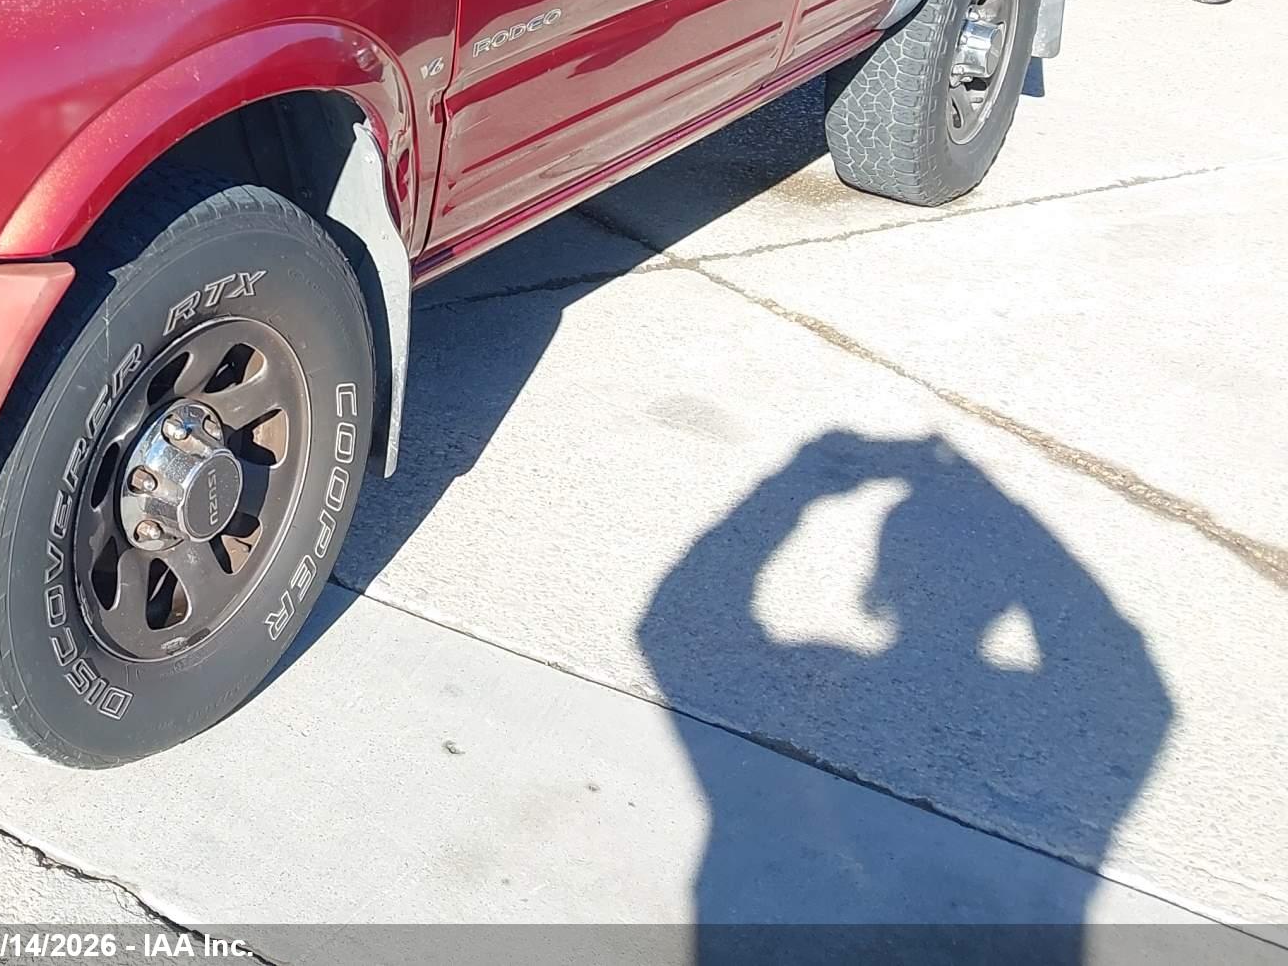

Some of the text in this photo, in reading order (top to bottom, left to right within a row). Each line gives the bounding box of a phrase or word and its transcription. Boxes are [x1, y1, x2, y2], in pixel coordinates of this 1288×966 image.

[472, 8, 562, 58] RODEO
[420, 56, 445, 80] V6
[43, 269, 268, 721] DISCOVERER RTX
[207, 468, 219, 526] ISUZU
[264, 382, 358, 641] COOPER
